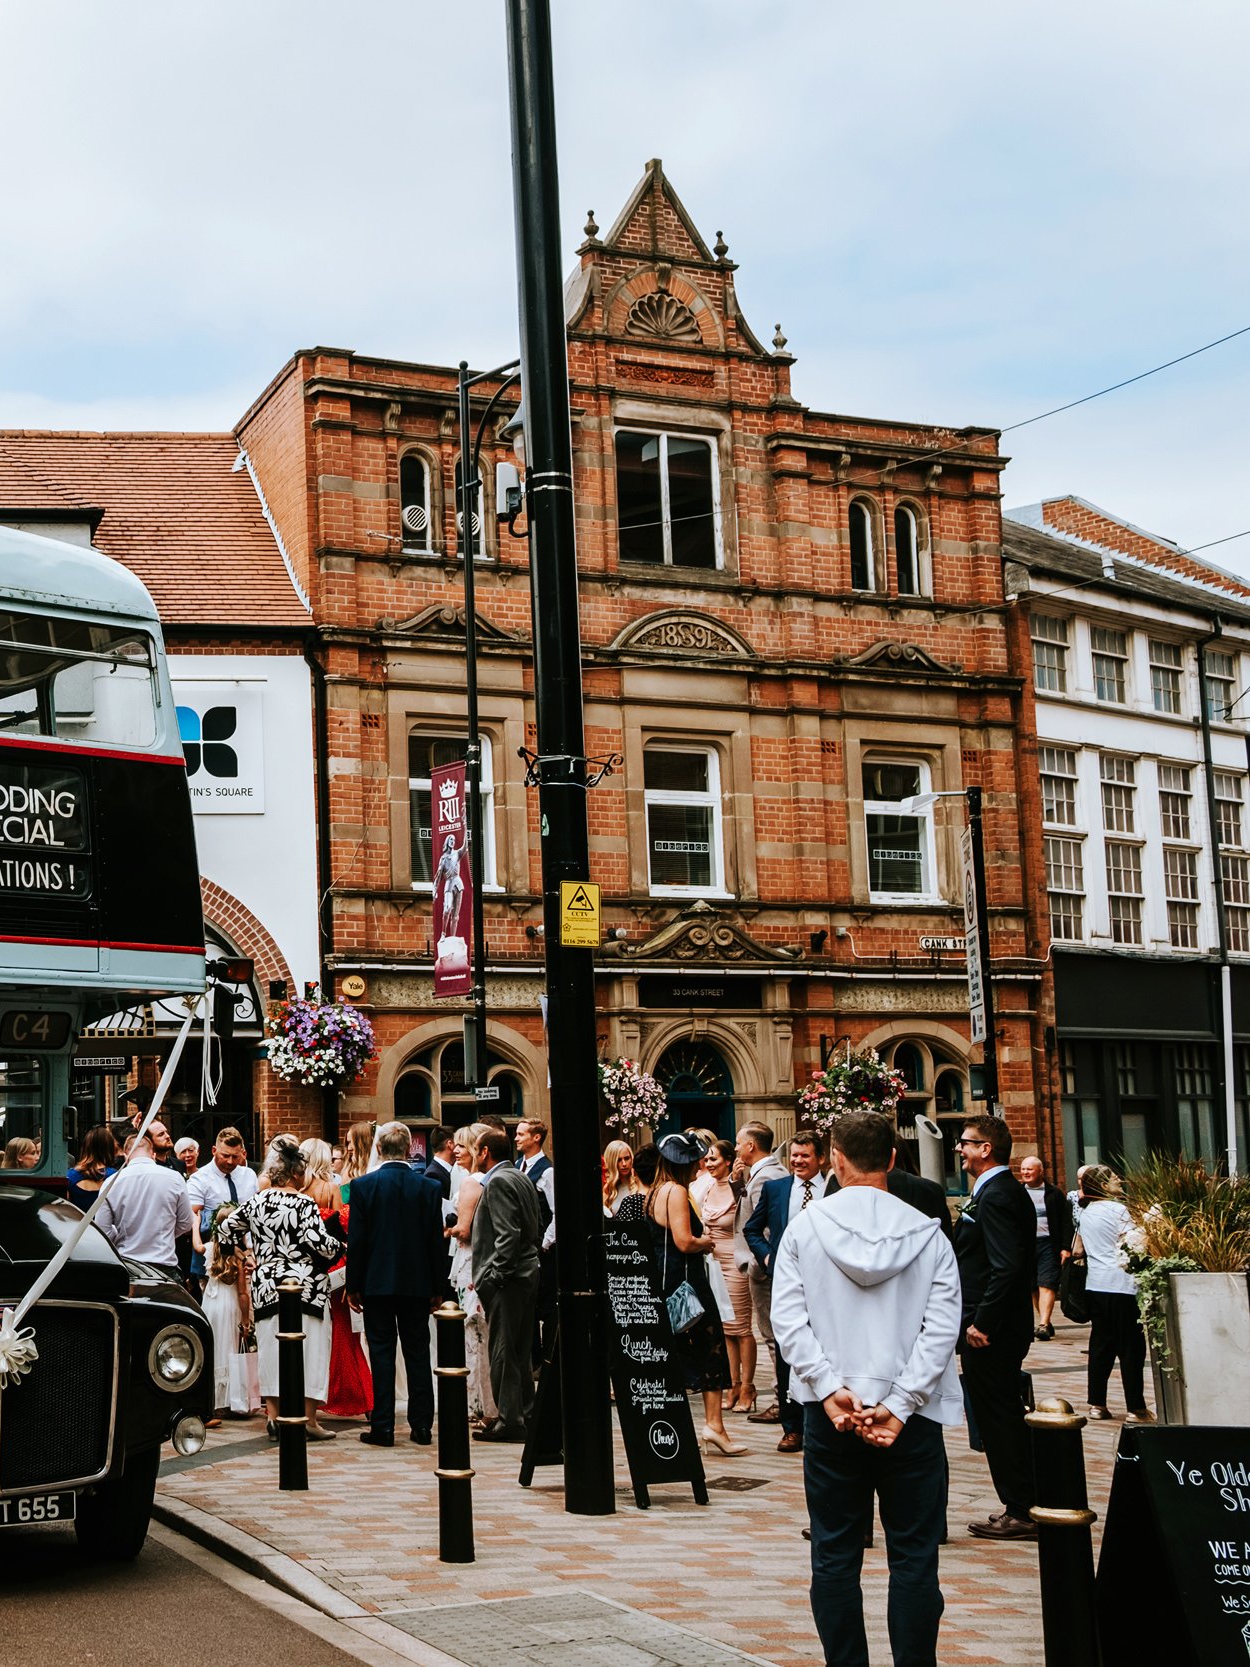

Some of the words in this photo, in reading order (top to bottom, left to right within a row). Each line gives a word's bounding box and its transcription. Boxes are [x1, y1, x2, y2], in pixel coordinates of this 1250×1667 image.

[215, 787, 254, 797] SQUARE
[438, 822, 462, 833] LEICESTER
[924, 939, 948, 949] CANK
[348, 982, 364, 990] Yale
[681, 988, 699, 996] CANK
[700, 988, 725, 996] STREET
[12, 1013, 50, 1042] C4
[605, 1231, 620, 1247] The
[621, 1334, 653, 1355] Lunch
[652, 1401, 664, 1409] hire
[1165, 1460, 1204, 1486] Ye
[18, 1495, 60, 1521] 655
[1208, 1540, 1240, 1559] WE
[1214, 1564, 1241, 1576] COME
[1221, 1595, 1240, 1608] We
